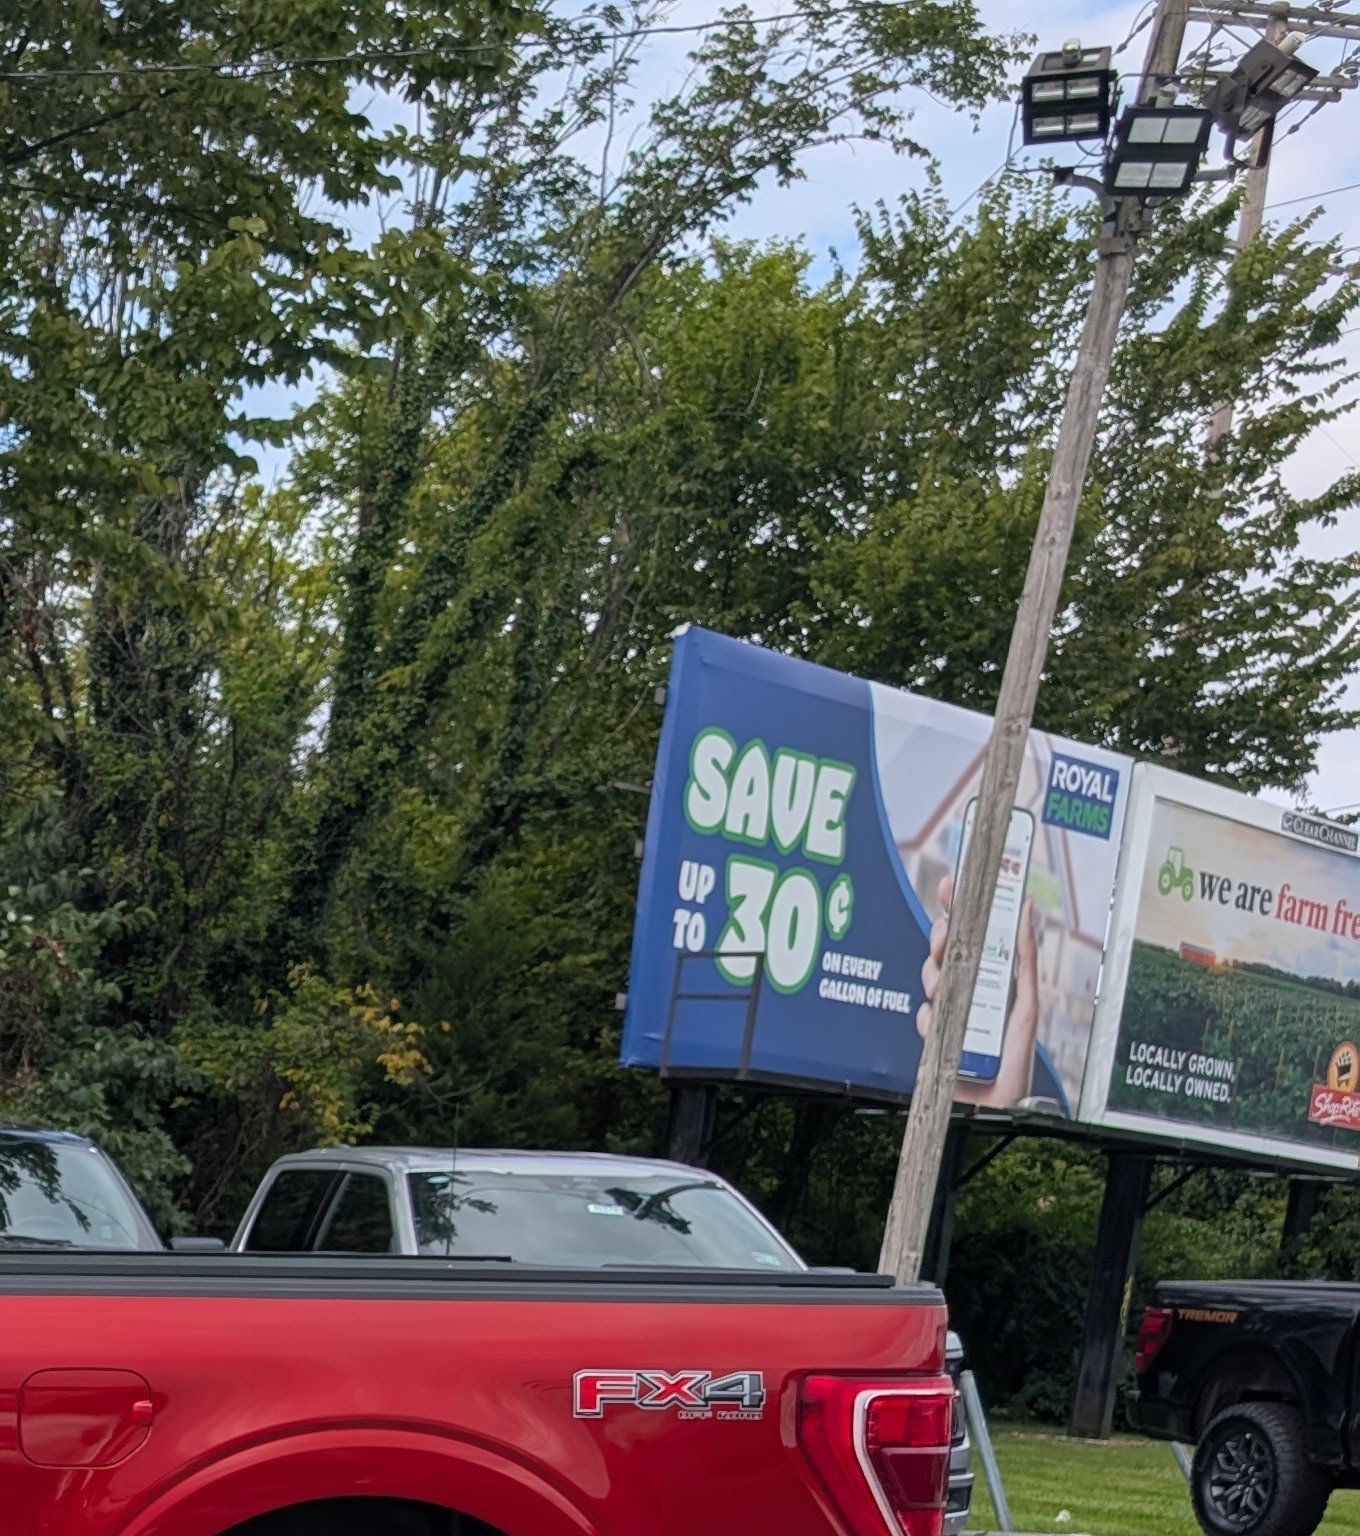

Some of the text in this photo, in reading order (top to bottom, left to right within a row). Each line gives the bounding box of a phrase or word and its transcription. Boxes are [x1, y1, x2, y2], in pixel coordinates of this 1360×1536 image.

[685, 729, 855, 861] SAVE
[1051, 759, 1113, 804] ROYAL
[1046, 791, 1110, 833] FARMS
[678, 860, 716, 904] UP
[1199, 871, 1232, 905] we
[1234, 881, 1273, 916] are
[1275, 883, 1329, 932] farm
[673, 908, 706, 952] TO
[822, 951, 883, 981] ON EVERY
[819, 977, 911, 1014] GALLON OF FUEL
[1129, 1041, 1235, 1083] LOCALLY GROWN,
[1125, 1064, 1232, 1104] LOCALLY OWNED.
[1178, 1308, 1238, 1324] TREMOR
[573, 1368, 766, 1419] FX4
